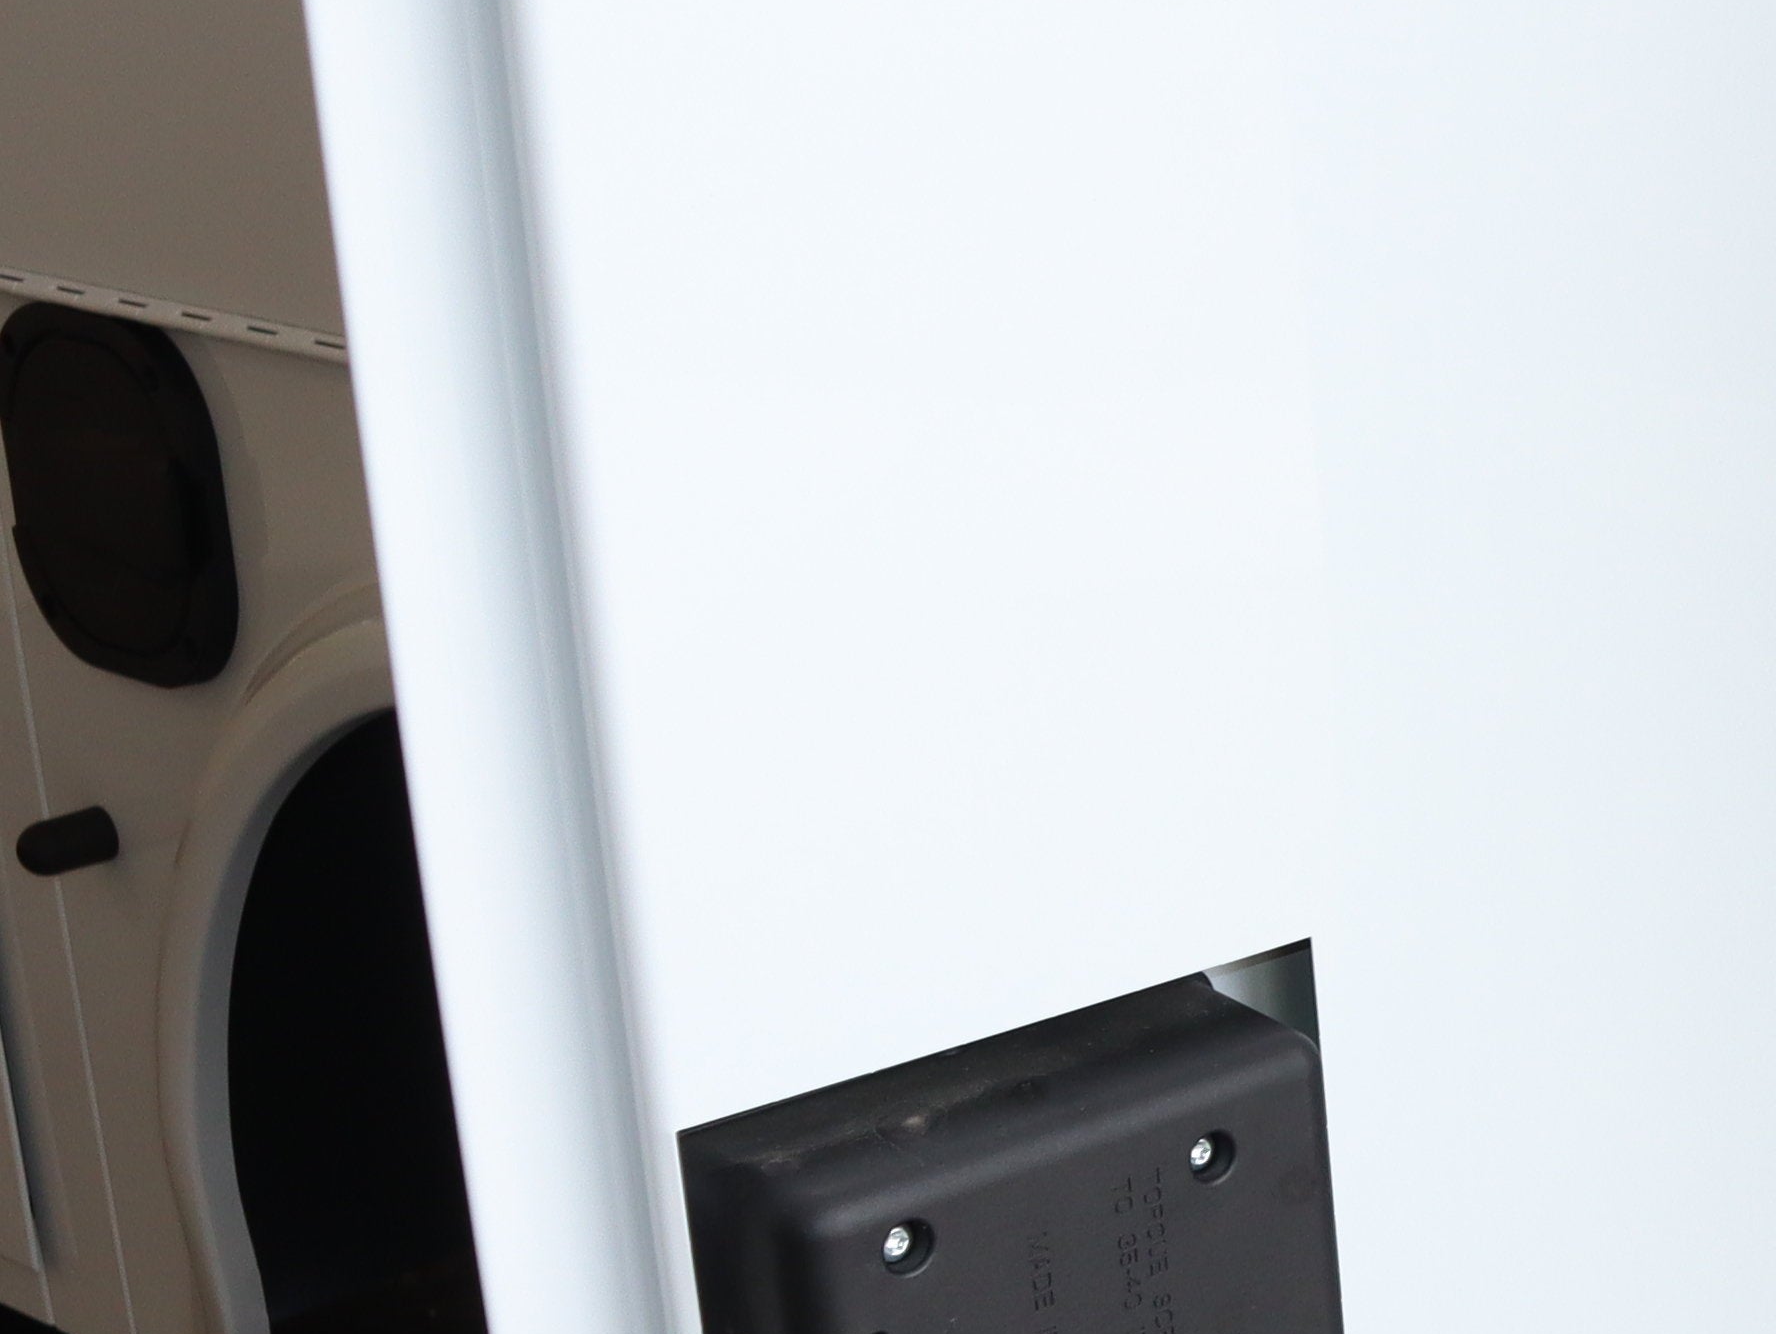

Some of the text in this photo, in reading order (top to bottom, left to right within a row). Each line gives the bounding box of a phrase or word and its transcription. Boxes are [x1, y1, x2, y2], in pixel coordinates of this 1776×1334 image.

[1112, 1174, 1134, 1215] TO
[1142, 1166, 1169, 1277] TORQUE
[1027, 1231, 1055, 1312] MADE
